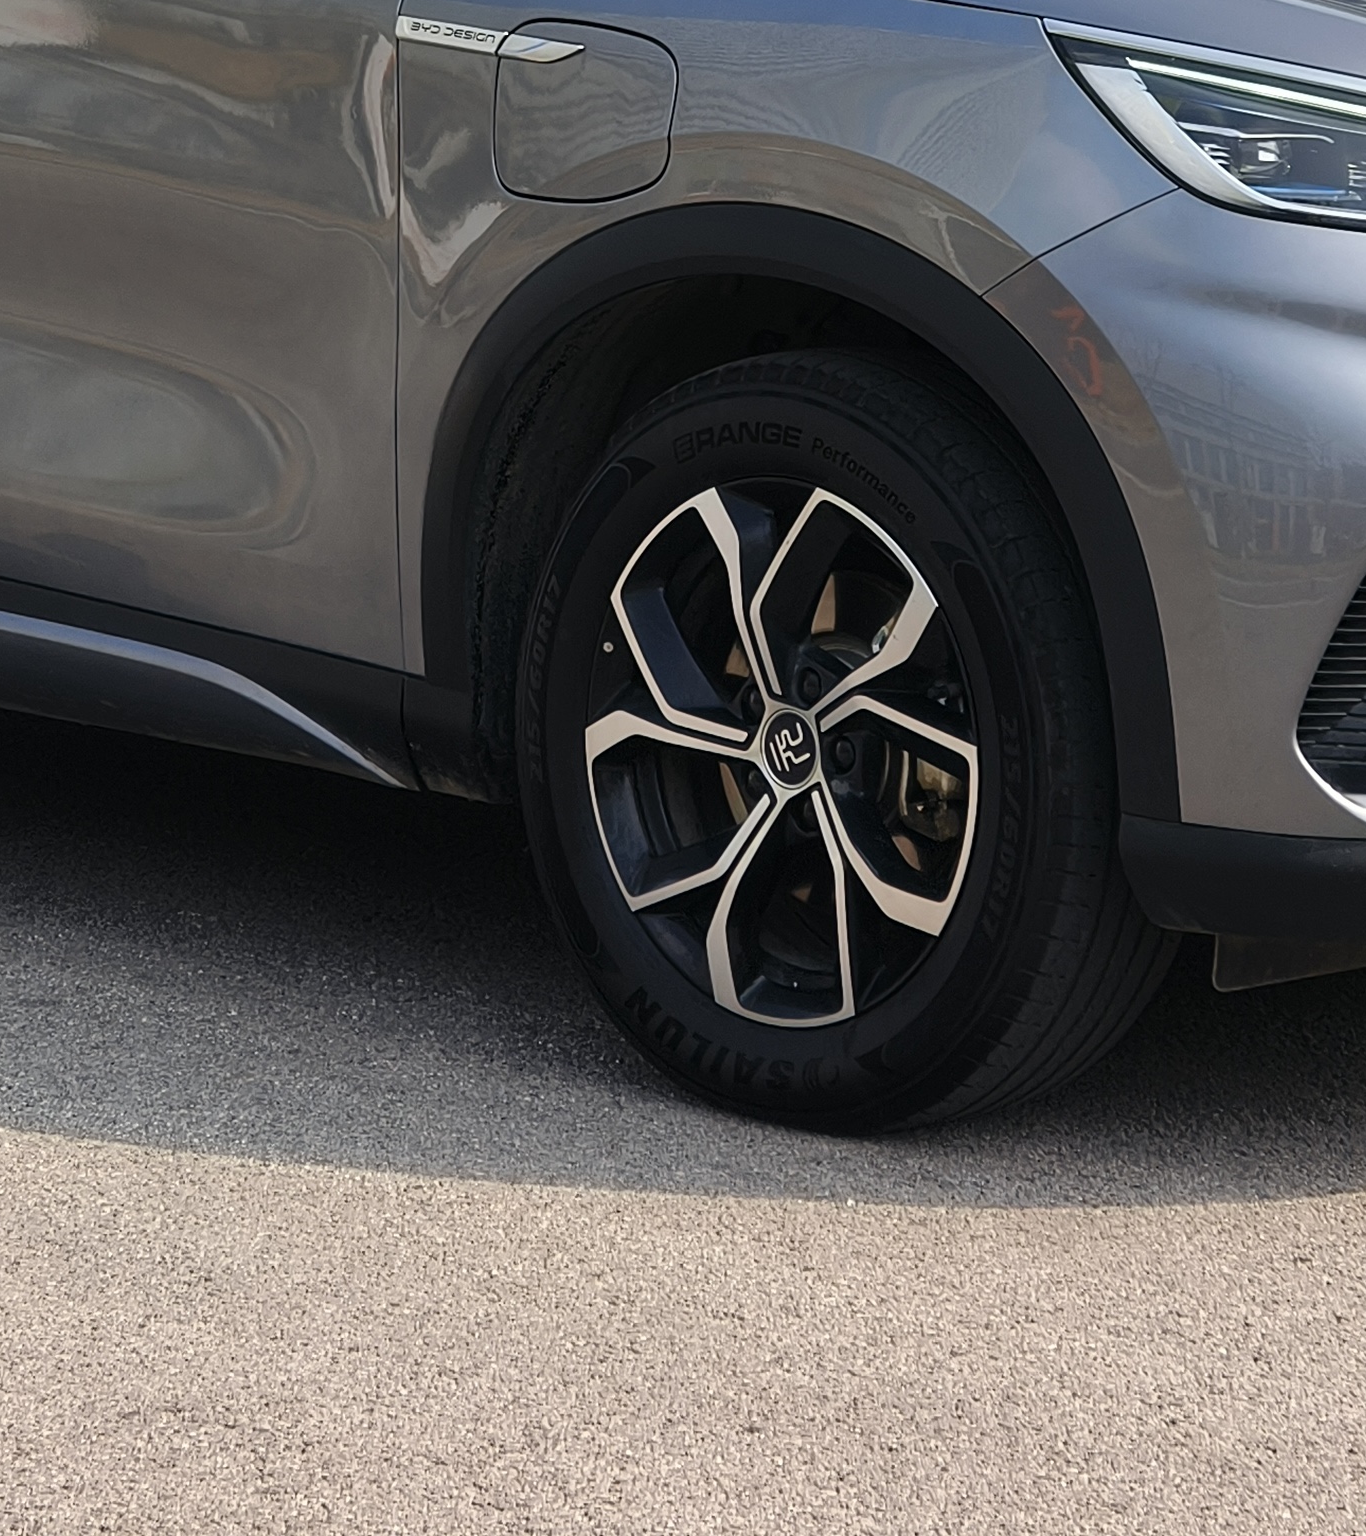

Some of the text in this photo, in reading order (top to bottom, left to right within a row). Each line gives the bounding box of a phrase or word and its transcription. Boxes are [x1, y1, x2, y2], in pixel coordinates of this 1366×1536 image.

[410, 21, 496, 44] BYD DESIGN
[810, 436, 918, 525] Performance
[623, 985, 796, 1090] SAILUN
